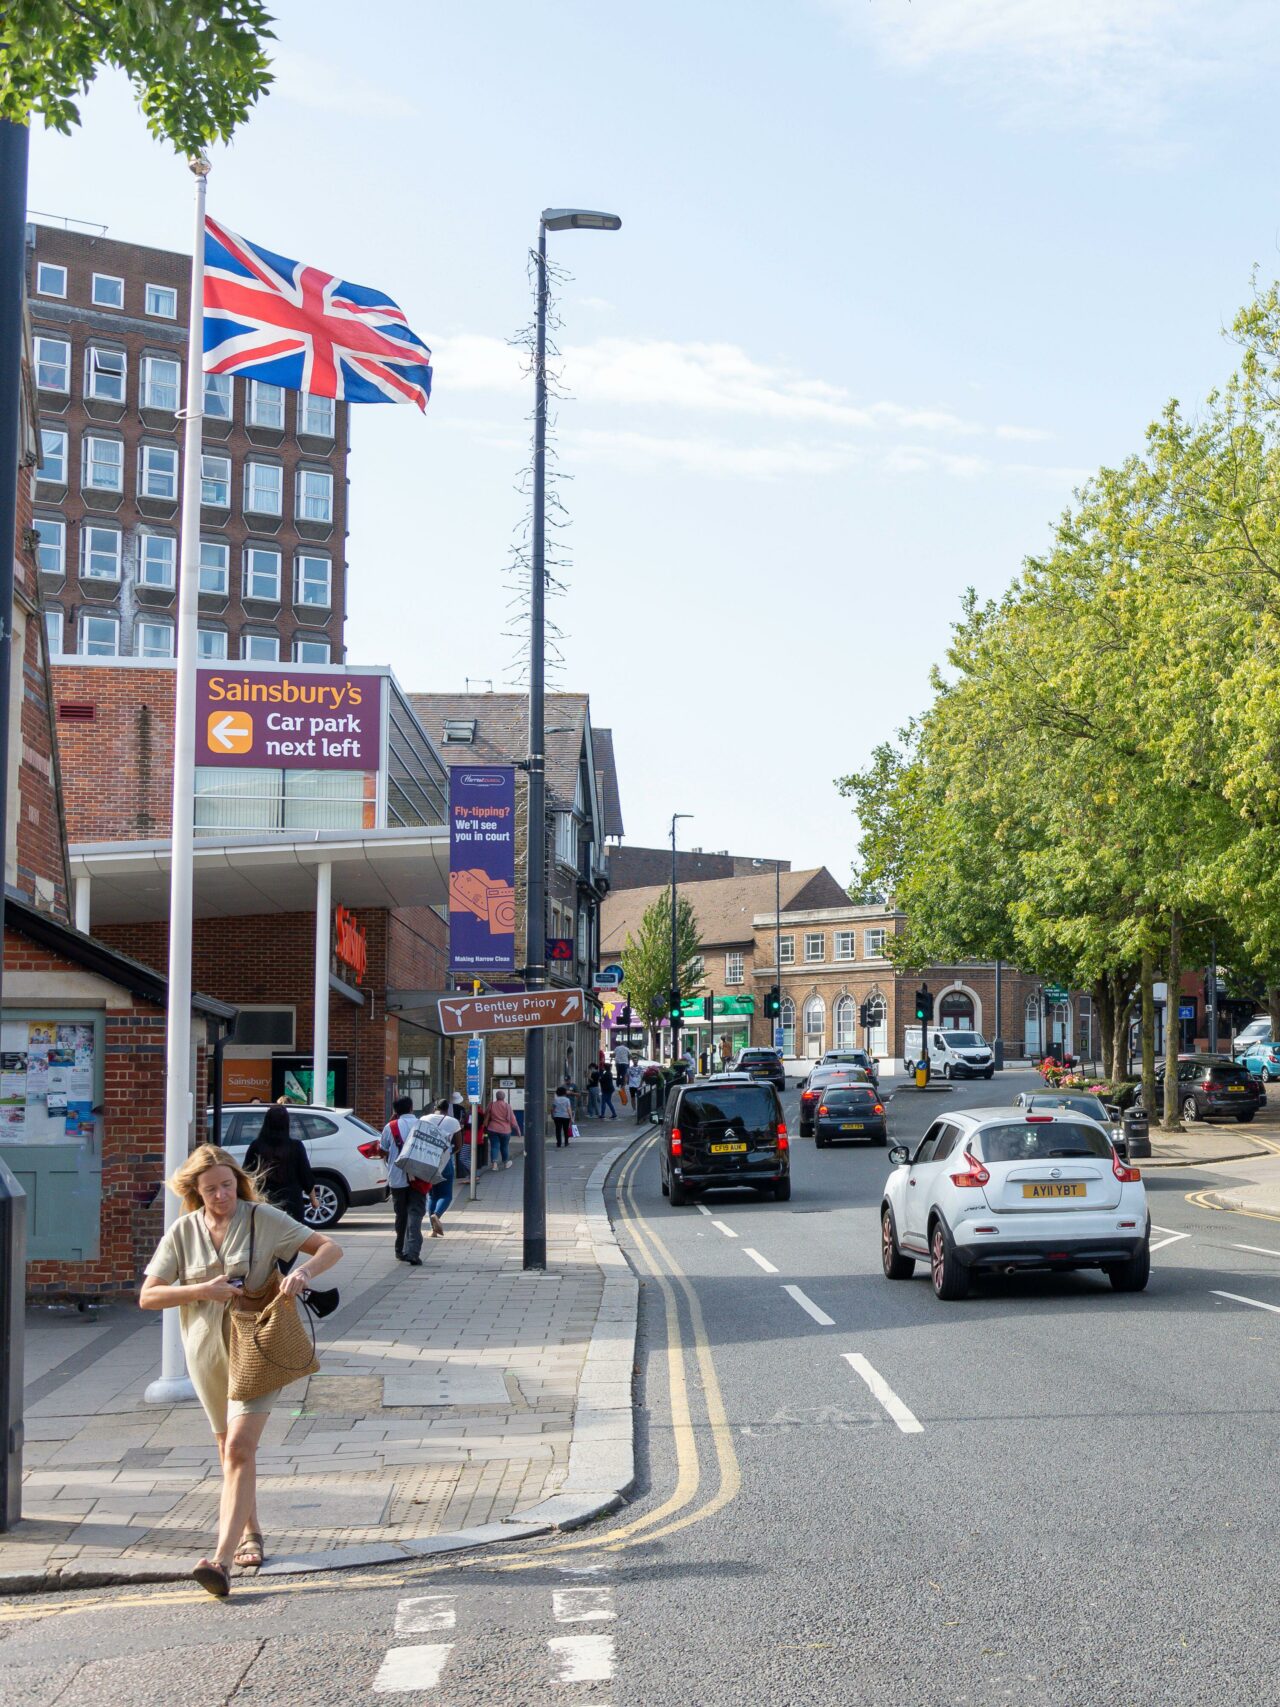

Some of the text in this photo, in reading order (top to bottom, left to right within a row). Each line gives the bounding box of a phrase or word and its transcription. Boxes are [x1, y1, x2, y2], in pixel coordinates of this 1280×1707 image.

[208, 677, 362, 709] Sainsbury's
[266, 712, 362, 736] Car park
[266, 738, 362, 757] next left
[454, 806, 510, 819] Fly-tipping?
[455, 819, 497, 830] We'll see
[455, 831, 510, 843] you in court
[455, 955, 474, 963] Making
[475, 998, 557, 1013] Bentley Priory
[493, 1012, 541, 1024] Museum
[1056, 1185, 1078, 1196] YBT
